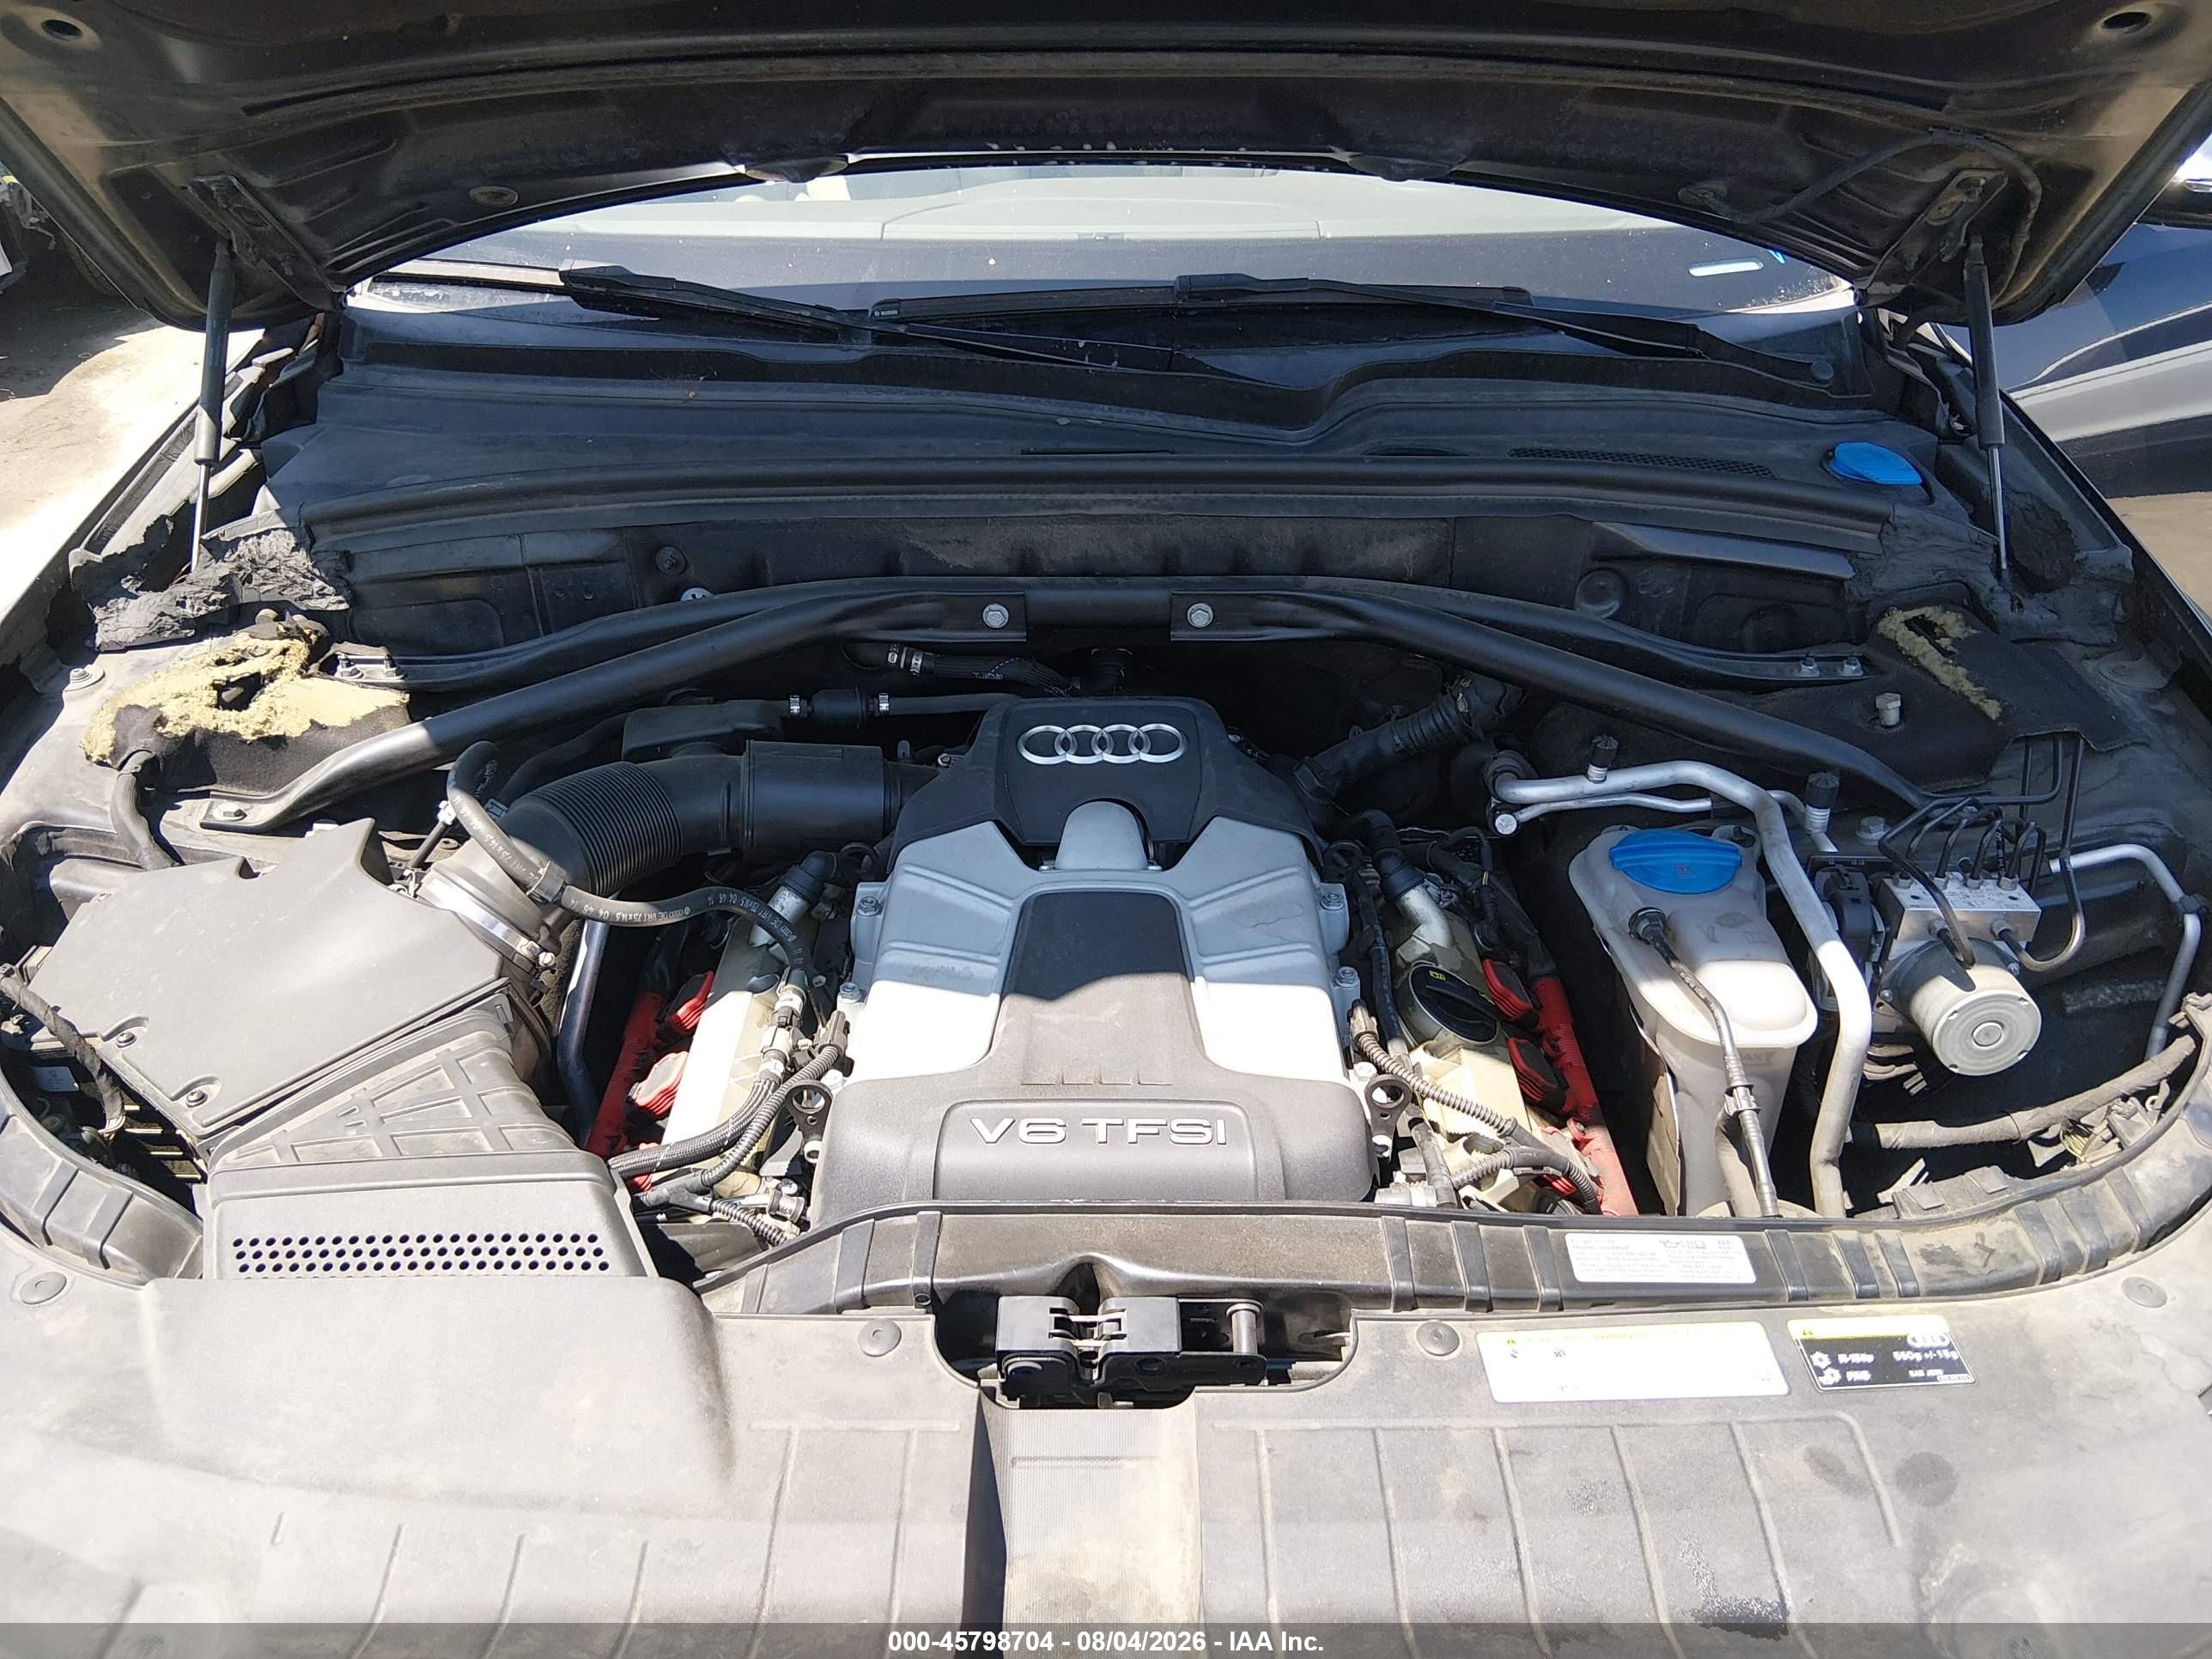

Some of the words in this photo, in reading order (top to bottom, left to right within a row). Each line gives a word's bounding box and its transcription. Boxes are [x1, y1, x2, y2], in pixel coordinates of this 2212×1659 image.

[643, 911, 657, 921] VRT
[969, 1118, 1066, 1144] V6
[1081, 1118, 1227, 1145] TFSI
